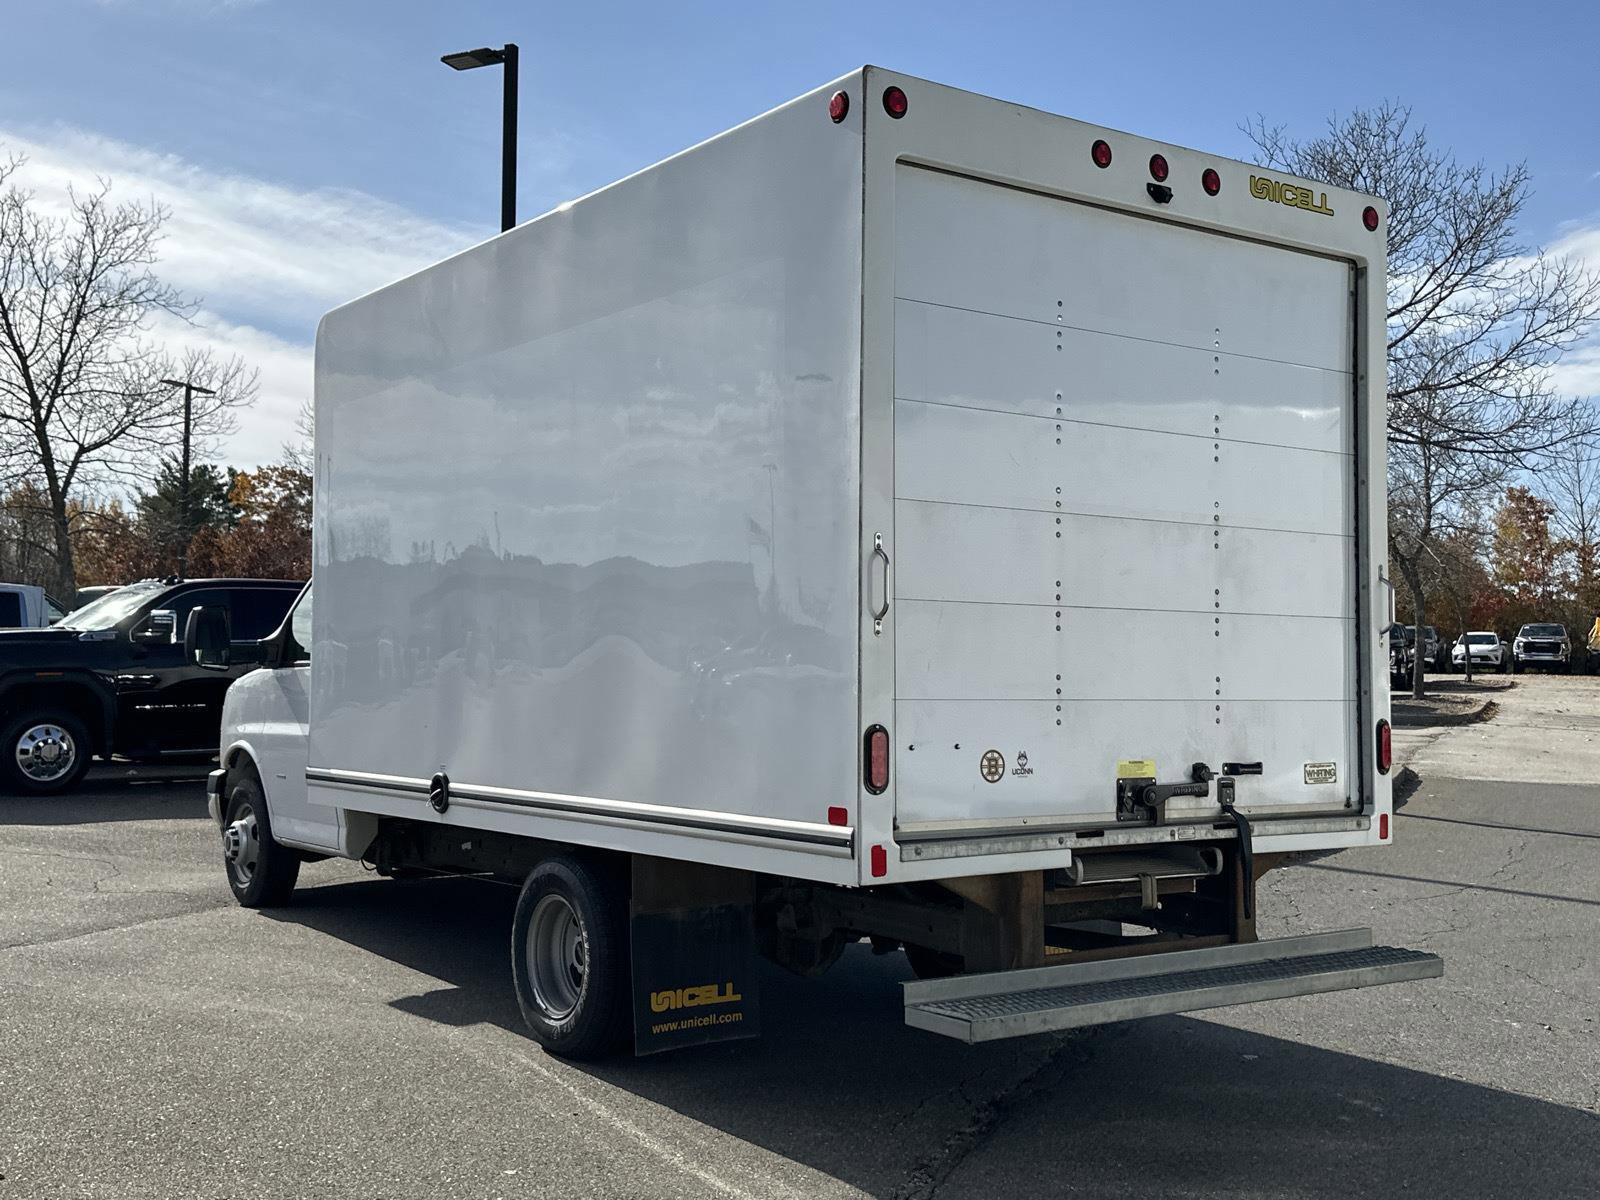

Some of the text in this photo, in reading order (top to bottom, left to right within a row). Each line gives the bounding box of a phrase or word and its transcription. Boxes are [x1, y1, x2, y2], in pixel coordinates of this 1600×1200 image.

[1249, 174, 1335, 216] UNICELL
[1011, 767, 1034, 776] UCONN
[650, 981, 742, 1013] UNICELL
[651, 1011, 743, 1034] www.unicell.com
